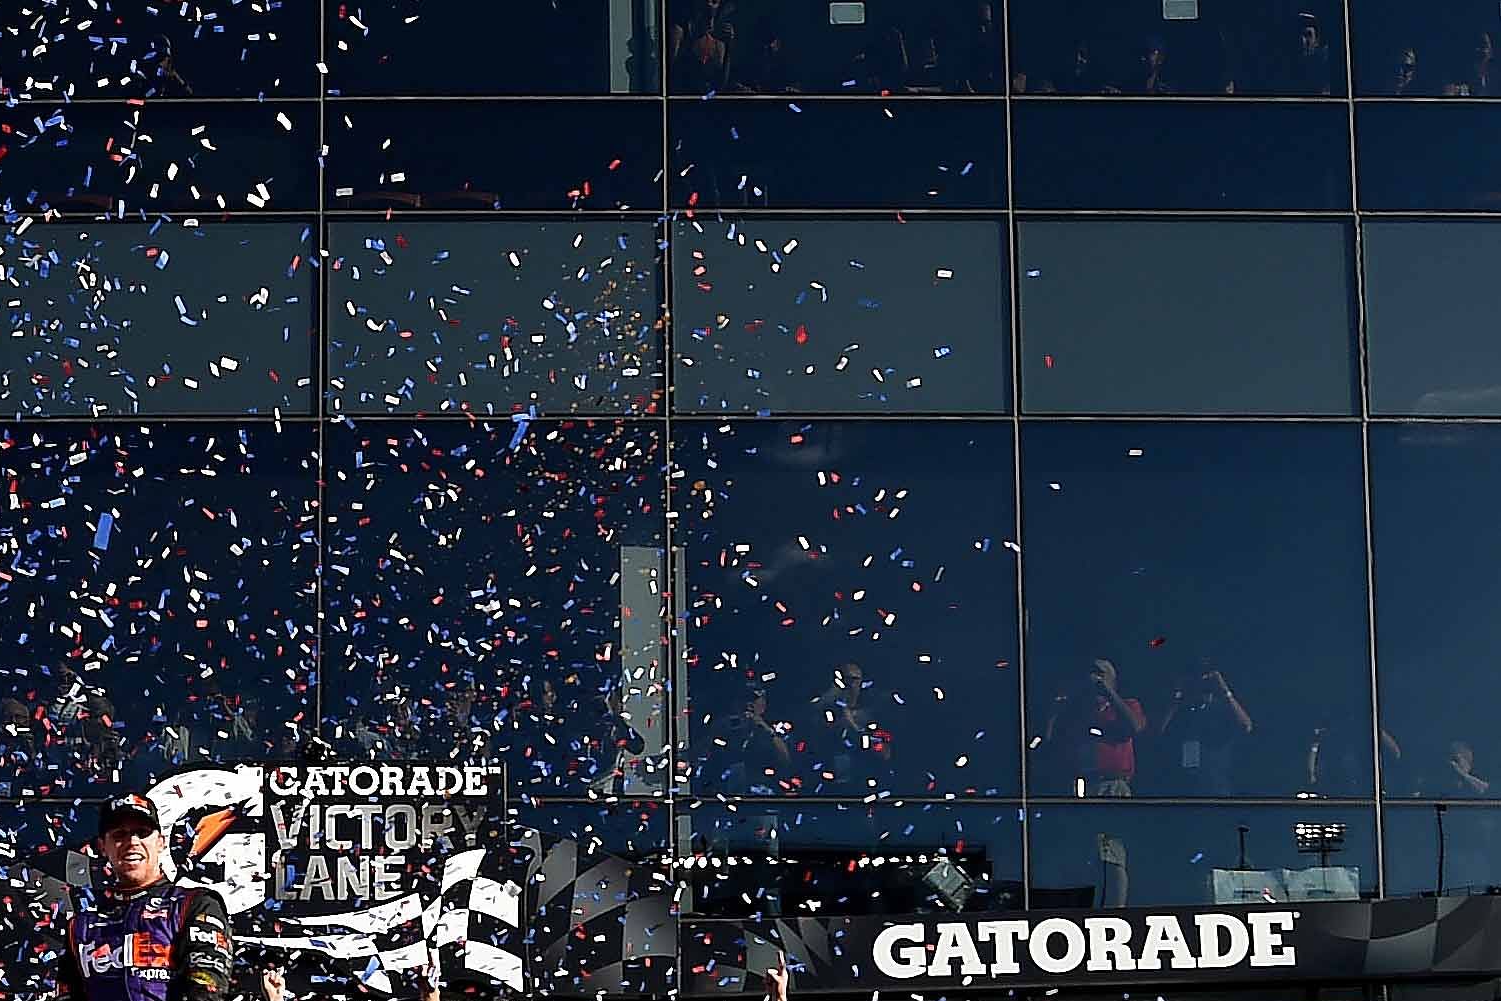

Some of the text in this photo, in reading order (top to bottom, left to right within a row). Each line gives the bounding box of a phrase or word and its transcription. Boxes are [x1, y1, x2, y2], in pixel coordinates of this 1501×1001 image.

[269, 766, 488, 796] GATORADE
[270, 803, 486, 851] VICTORY
[275, 854, 406, 901] LANE
[79, 932, 175, 978] FedEx
[872, 911, 1297, 978] GATORADE
